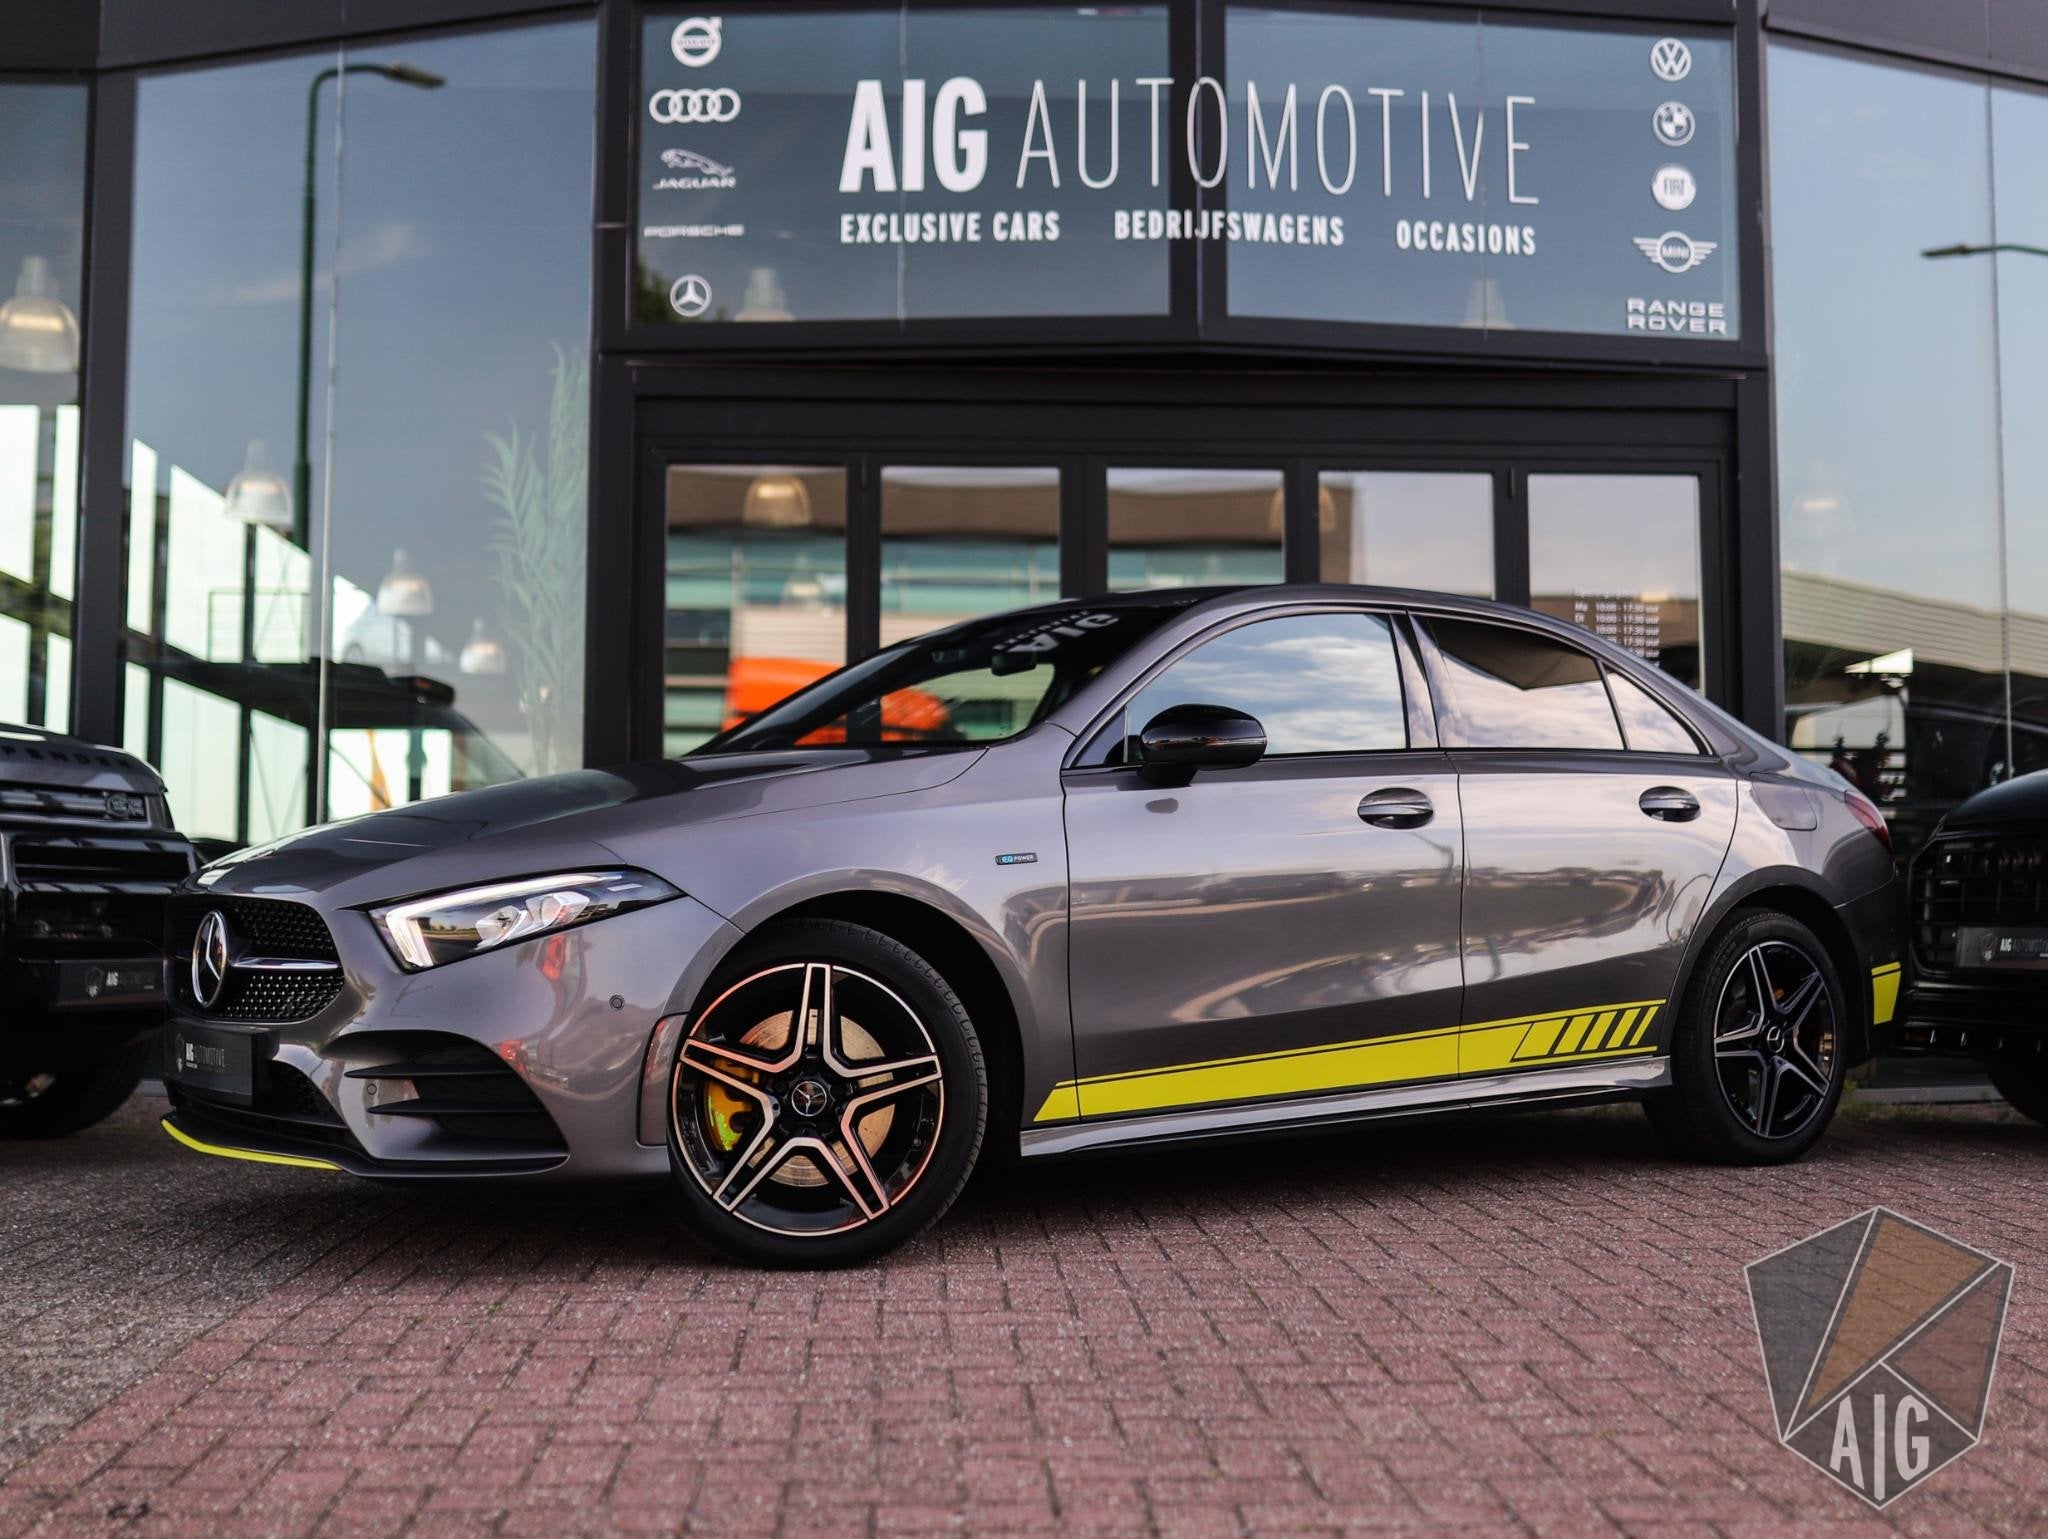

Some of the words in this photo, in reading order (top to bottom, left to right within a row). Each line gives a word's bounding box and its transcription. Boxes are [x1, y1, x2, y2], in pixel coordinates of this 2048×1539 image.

[839, 77, 988, 192] AIG
[1016, 76, 1540, 204] AUTOMOTIVE
[652, 177, 736, 189] JAGUAR
[643, 224, 745, 237] PORSCHE
[840, 212, 981, 243] EXCLUSIVE
[993, 211, 1061, 242] CARS
[1114, 210, 1345, 246] BEDRIJFSWAGENS
[1396, 219, 1536, 256] OCCASIONS
[1661, 245, 1690, 260] MINI
[1627, 297, 1725, 318] RANGE
[1627, 314, 1726, 335] ROVER
